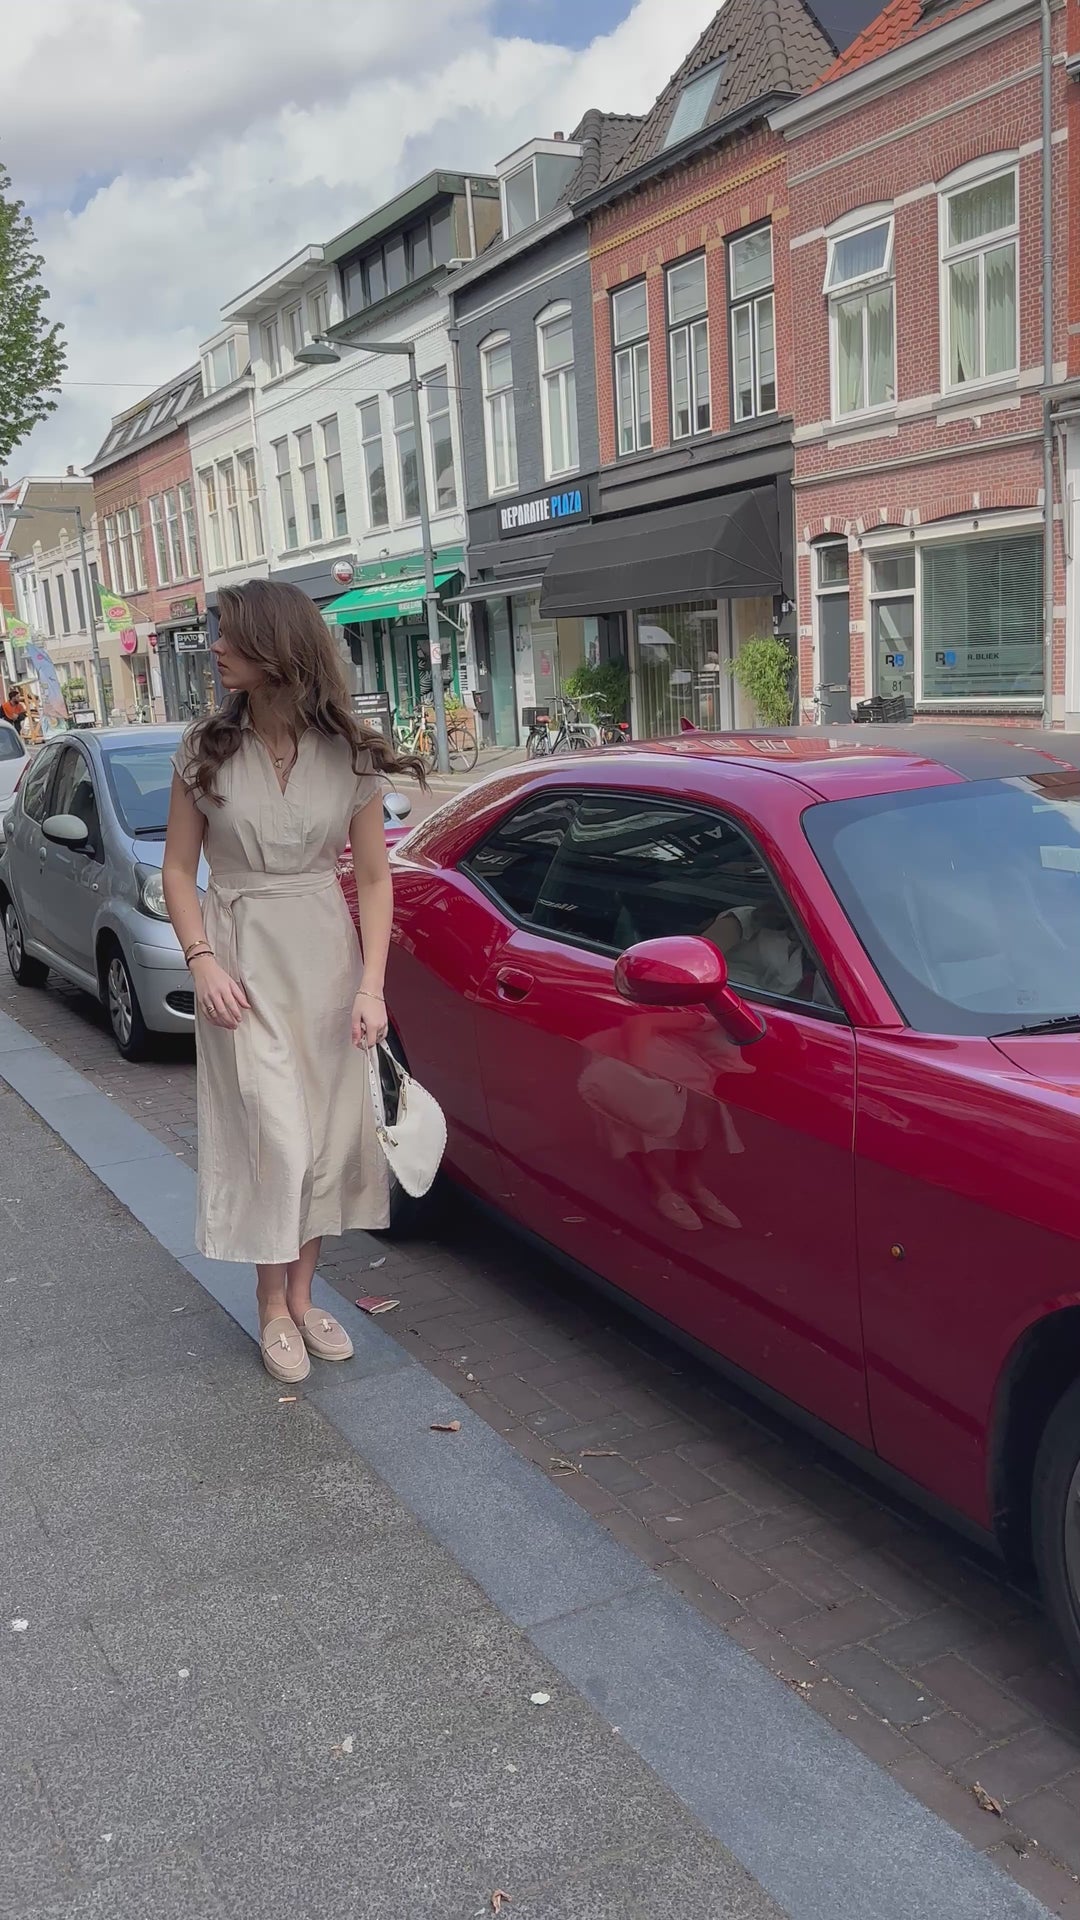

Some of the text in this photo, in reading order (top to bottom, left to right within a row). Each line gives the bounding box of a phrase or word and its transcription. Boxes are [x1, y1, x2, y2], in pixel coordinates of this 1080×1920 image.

[501, 489, 582, 530] REPARATIE PLAZA
[885, 653, 905, 668] RB
[892, 680, 903, 692] 81
